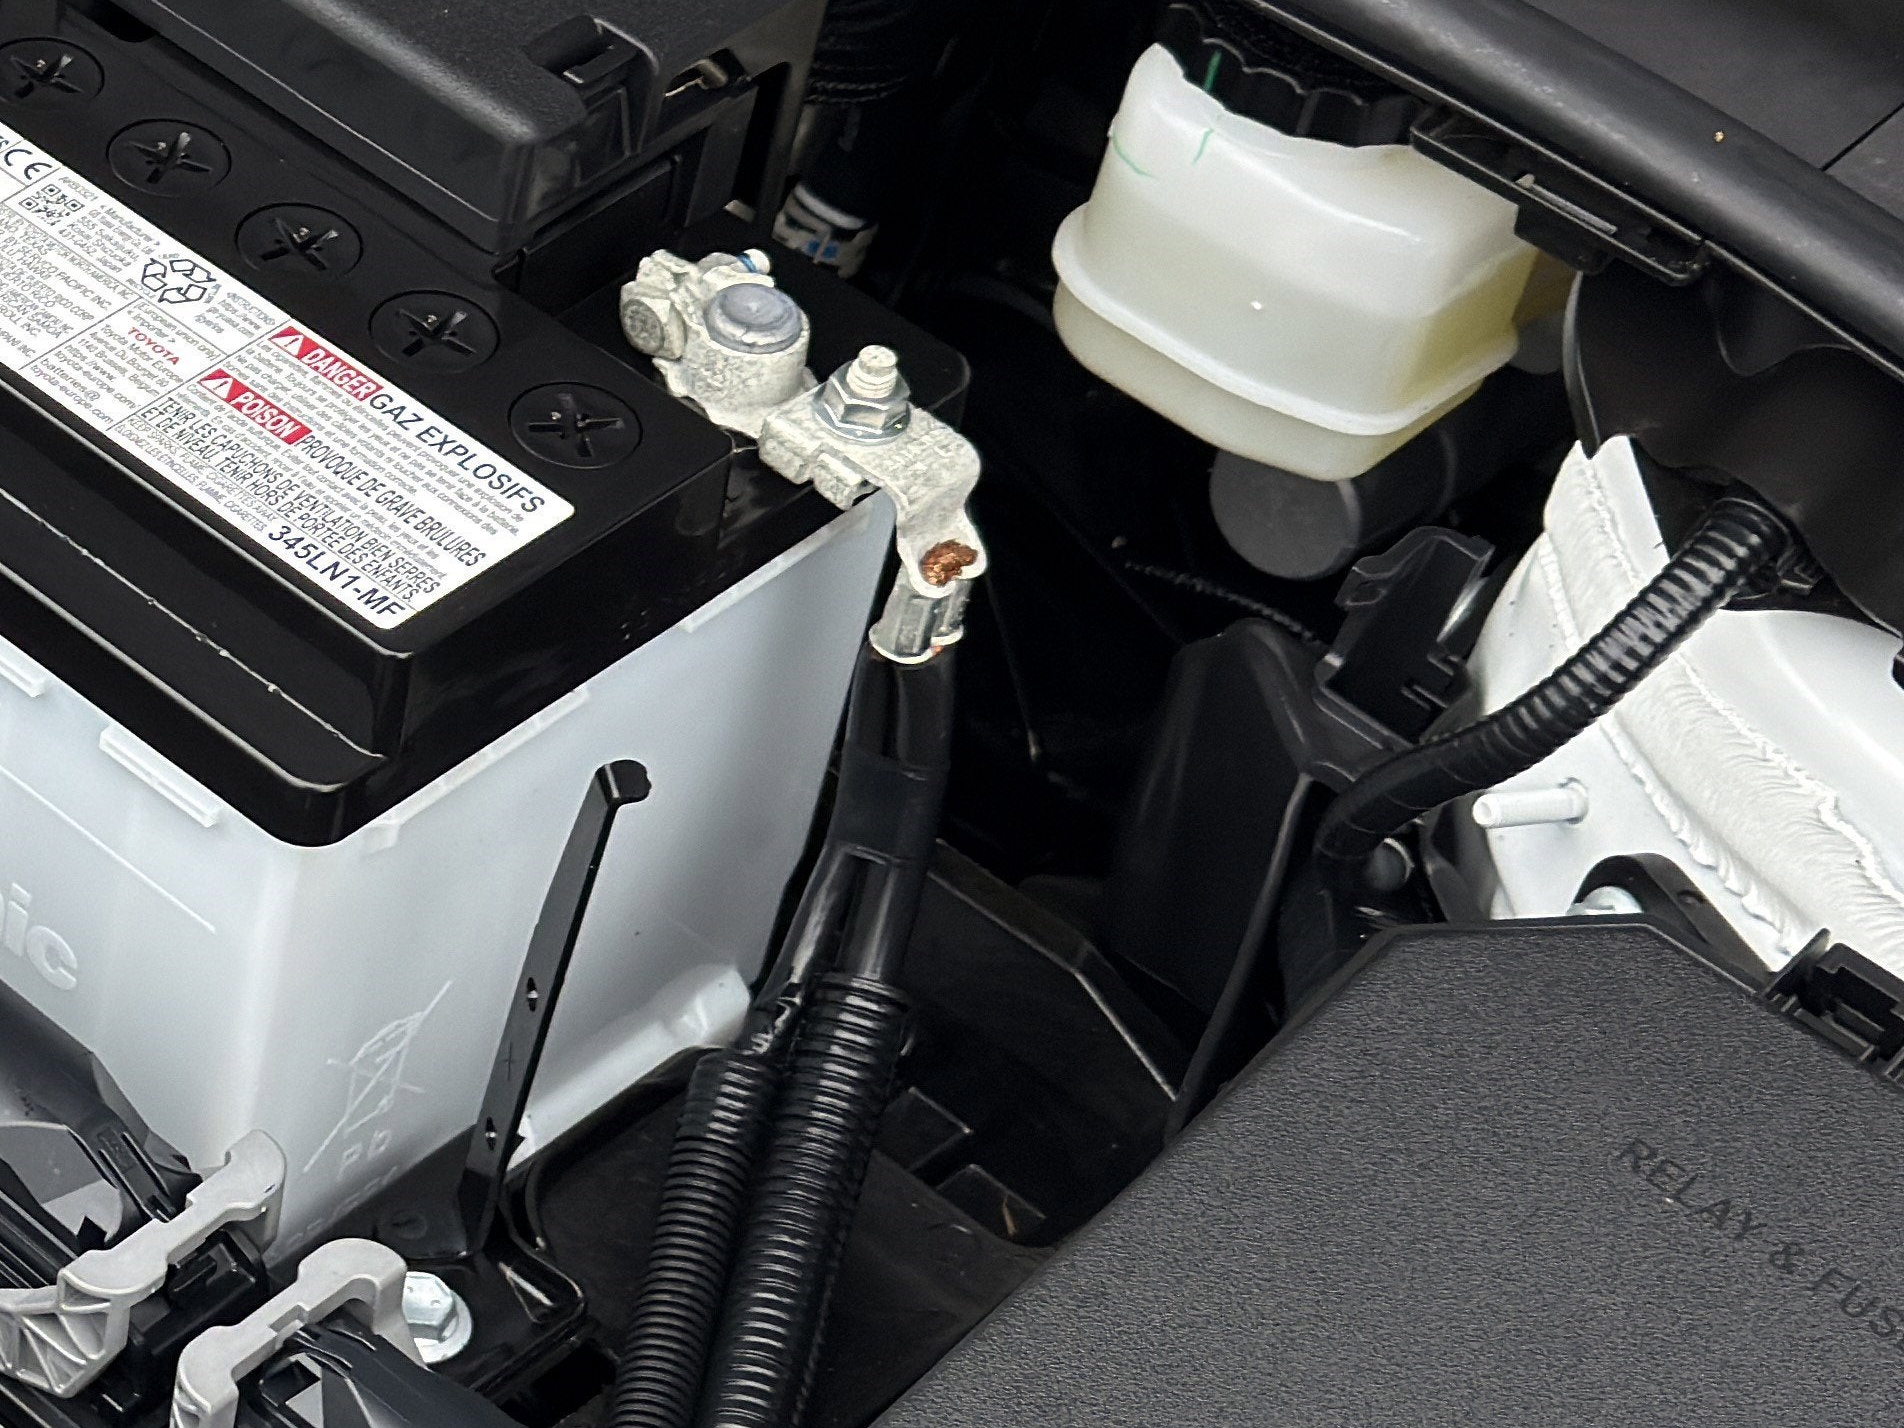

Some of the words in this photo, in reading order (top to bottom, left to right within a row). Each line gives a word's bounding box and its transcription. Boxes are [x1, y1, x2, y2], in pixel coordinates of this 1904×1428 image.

[39, 357, 101, 402] batteries@
[127, 326, 180, 365] TOYOTA
[300, 348, 377, 399] DANGER
[229, 391, 301, 439] POISON
[369, 393, 424, 431] GAZ
[414, 425, 545, 513] EXPLOSIFS
[140, 406, 166, 422] ET
[154, 416, 182, 434] DE
[171, 427, 221, 462] NIVEAU.
[214, 456, 254, 485] TENIR
[245, 478, 286, 506] HORS
[276, 500, 303, 518] DE
[292, 512, 346, 549] PORTEE
[336, 542, 369, 564] DES
[360, 558, 420, 602] ENFANTS.
[157, 396, 197, 425] TENIR
[187, 418, 218, 439] LES
[209, 433, 284, 484] CAPUCHONS
[274, 478, 301, 496] DE
[292, 489, 369, 543] VENTILATION
[359, 537, 396, 562] BIEN
[387, 556, 441, 594] SERRES
[293, 434, 369, 486] PROVOQUE
[355, 477, 387, 498] DE
[374, 489, 426, 524] GRAVE
[412, 515, 487, 567] BRULURES
[267, 525, 406, 615] 345LN1-MF
[1615, 1138, 1768, 1242] RELAY
[1769, 1242, 1805, 1272] &
[1806, 1267, 1904, 1348] FUS
